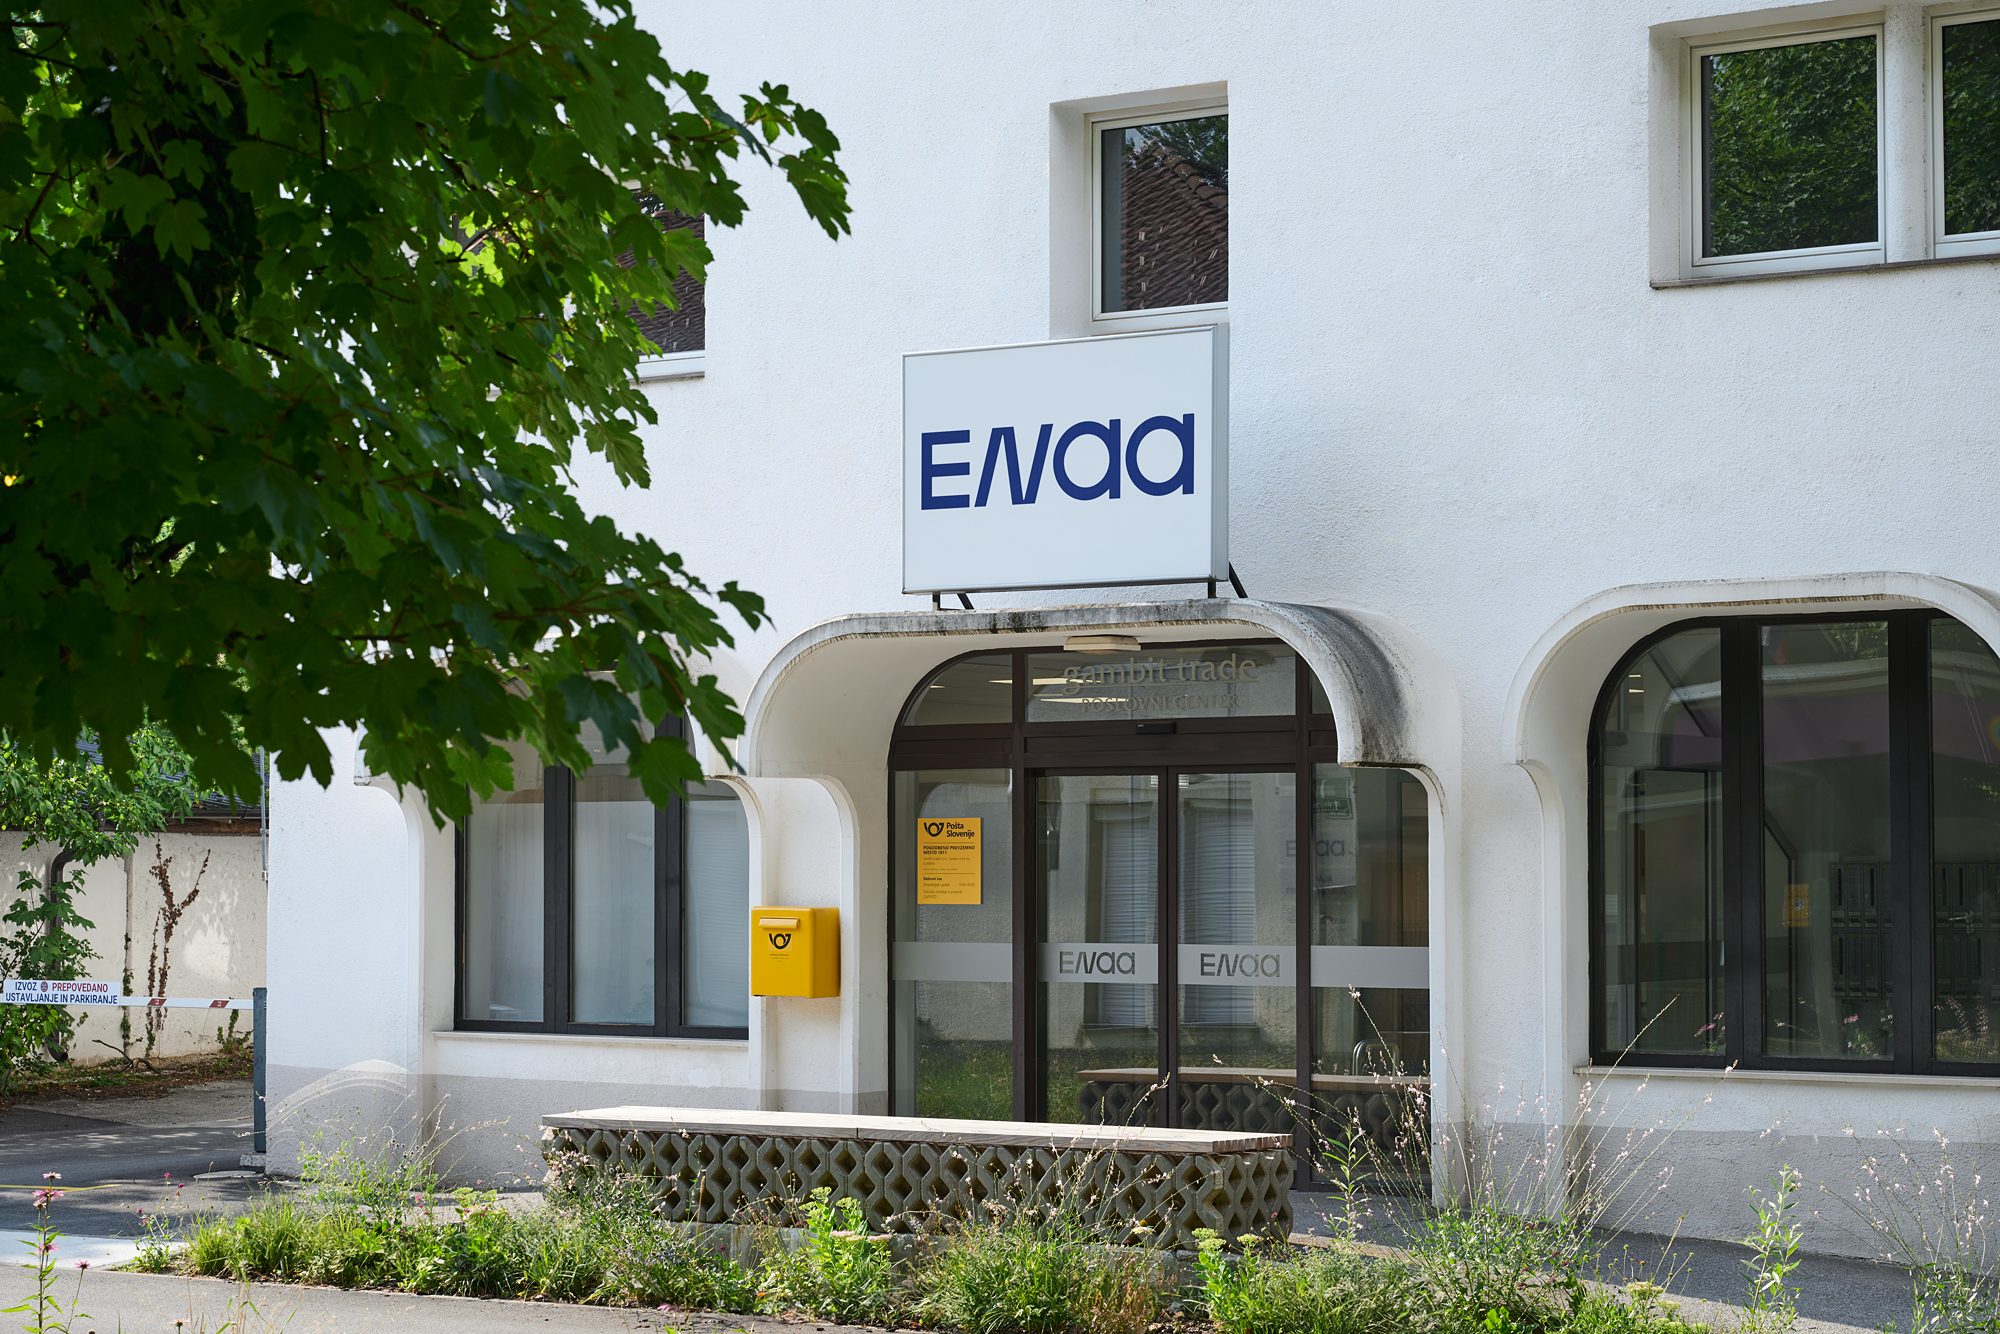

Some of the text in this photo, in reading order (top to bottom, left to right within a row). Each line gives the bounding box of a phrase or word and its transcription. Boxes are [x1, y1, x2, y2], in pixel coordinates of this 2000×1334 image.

[1062, 653, 1258, 695] gambit trade
[1081, 694, 1239, 713] POSLOVNI CENTER
[946, 830, 975, 839] Slovenije
[15, 981, 108, 992] IZVOZ PREPOVEDANO
[5, 992, 118, 1005] USTAVLJANJE IN PARKIRANJE
